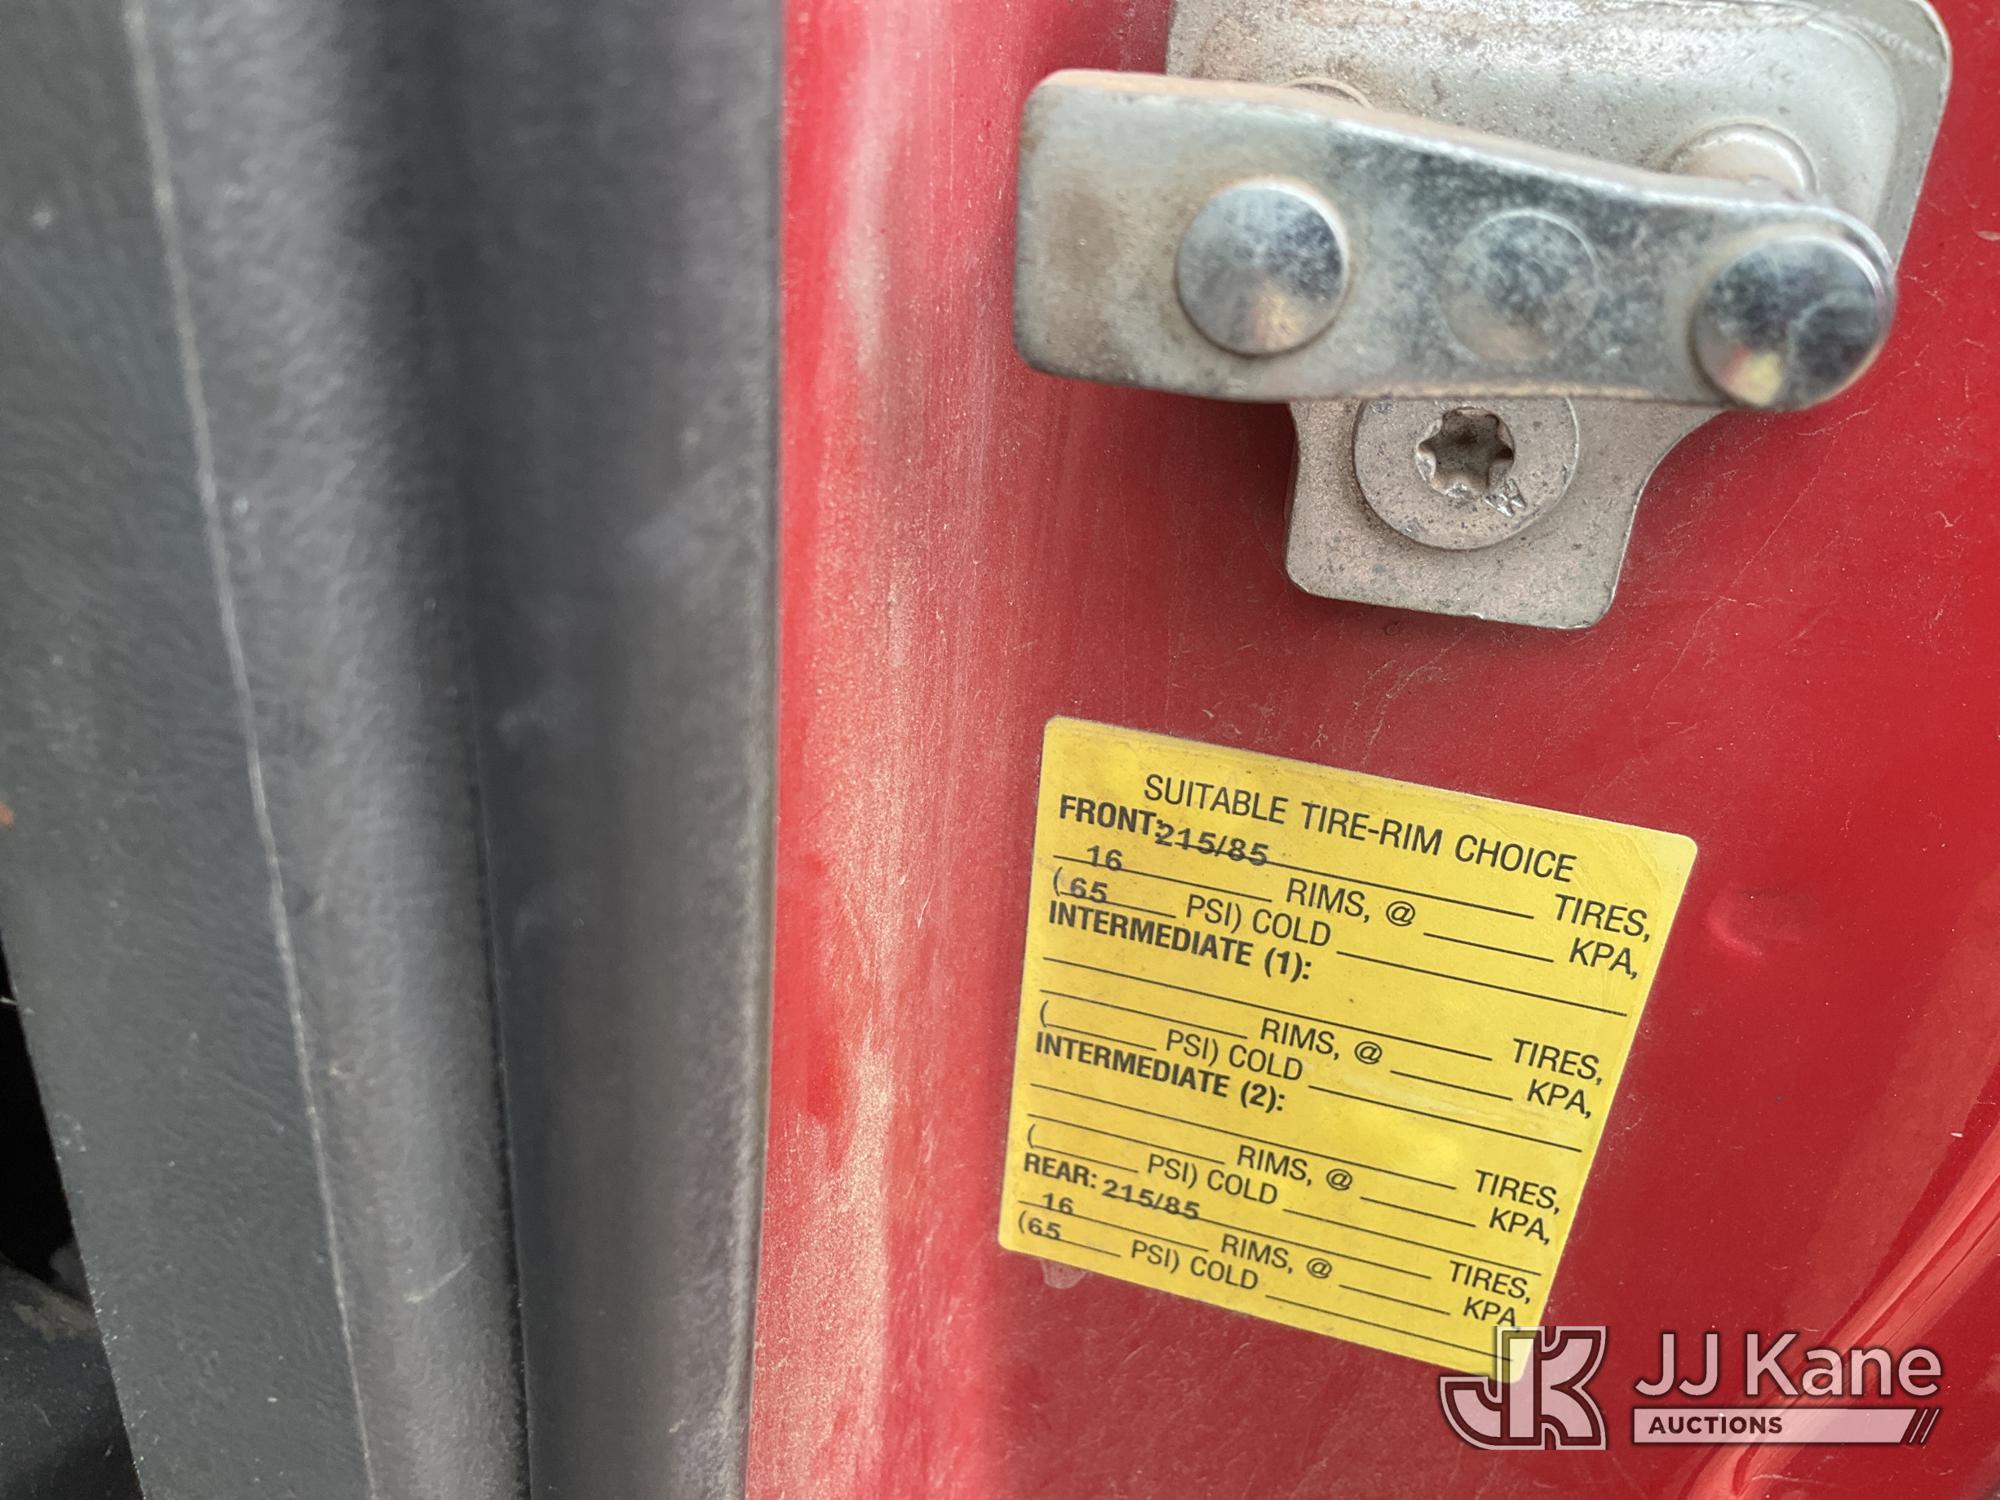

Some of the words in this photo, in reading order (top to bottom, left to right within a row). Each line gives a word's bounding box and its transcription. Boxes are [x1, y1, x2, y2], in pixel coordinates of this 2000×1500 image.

[1144, 773, 1289, 825] SUITABLE
[1301, 801, 1444, 856] TIRE-RIM
[1454, 833, 1578, 883] CHOICE
[1086, 844, 1124, 872] 16
[1286, 877, 1371, 924] RIMS,
[1385, 900, 1416, 927] @
[1568, 937, 1639, 980] KPA,
[1155, 823, 1269, 867] 215/85
[1555, 893, 1651, 943] TIRES,
[1186, 894, 1242, 933] PSI)
[1252, 908, 1331, 947] COLD
[1048, 900, 1254, 967] INTERMEDIATE
[1264, 947, 1312, 983] (1):
[1035, 1031, 1230, 1098] INTERMEDIATE
[1240, 1081, 1285, 1113] (2):
[1166, 1028, 1219, 1067] PSI)
[1229, 1044, 1303, 1082] COLD
[1260, 1017, 1339, 1060] RIMS,
[1354, 1040, 1383, 1065] @
[1526, 1079, 1592, 1118] KPA,
[1512, 1037, 1603, 1085] TIRES,
[1147, 1153, 1198, 1189] PSI)
[1207, 1169, 1278, 1205] COLD
[1236, 1144, 1312, 1187] RIMS,
[1326, 1168, 1353, 1191] @
[1488, 1207, 1550, 1245] KPA,
[1475, 1169, 1561, 1215] TIRES,
[1024, 1152, 1097, 1189] REAR:
[1102, 1178, 1200, 1220] 215/85
[1450, 1260, 1531, 1305] TIRES,
[1042, 1192, 1074, 1215] 16
[1221, 1234, 1293, 1274] RIMS,
[1306, 1257, 1333, 1279] @
[1131, 1239, 1180, 1274] PSI)
[1190, 1256, 1259, 1290] COLD
